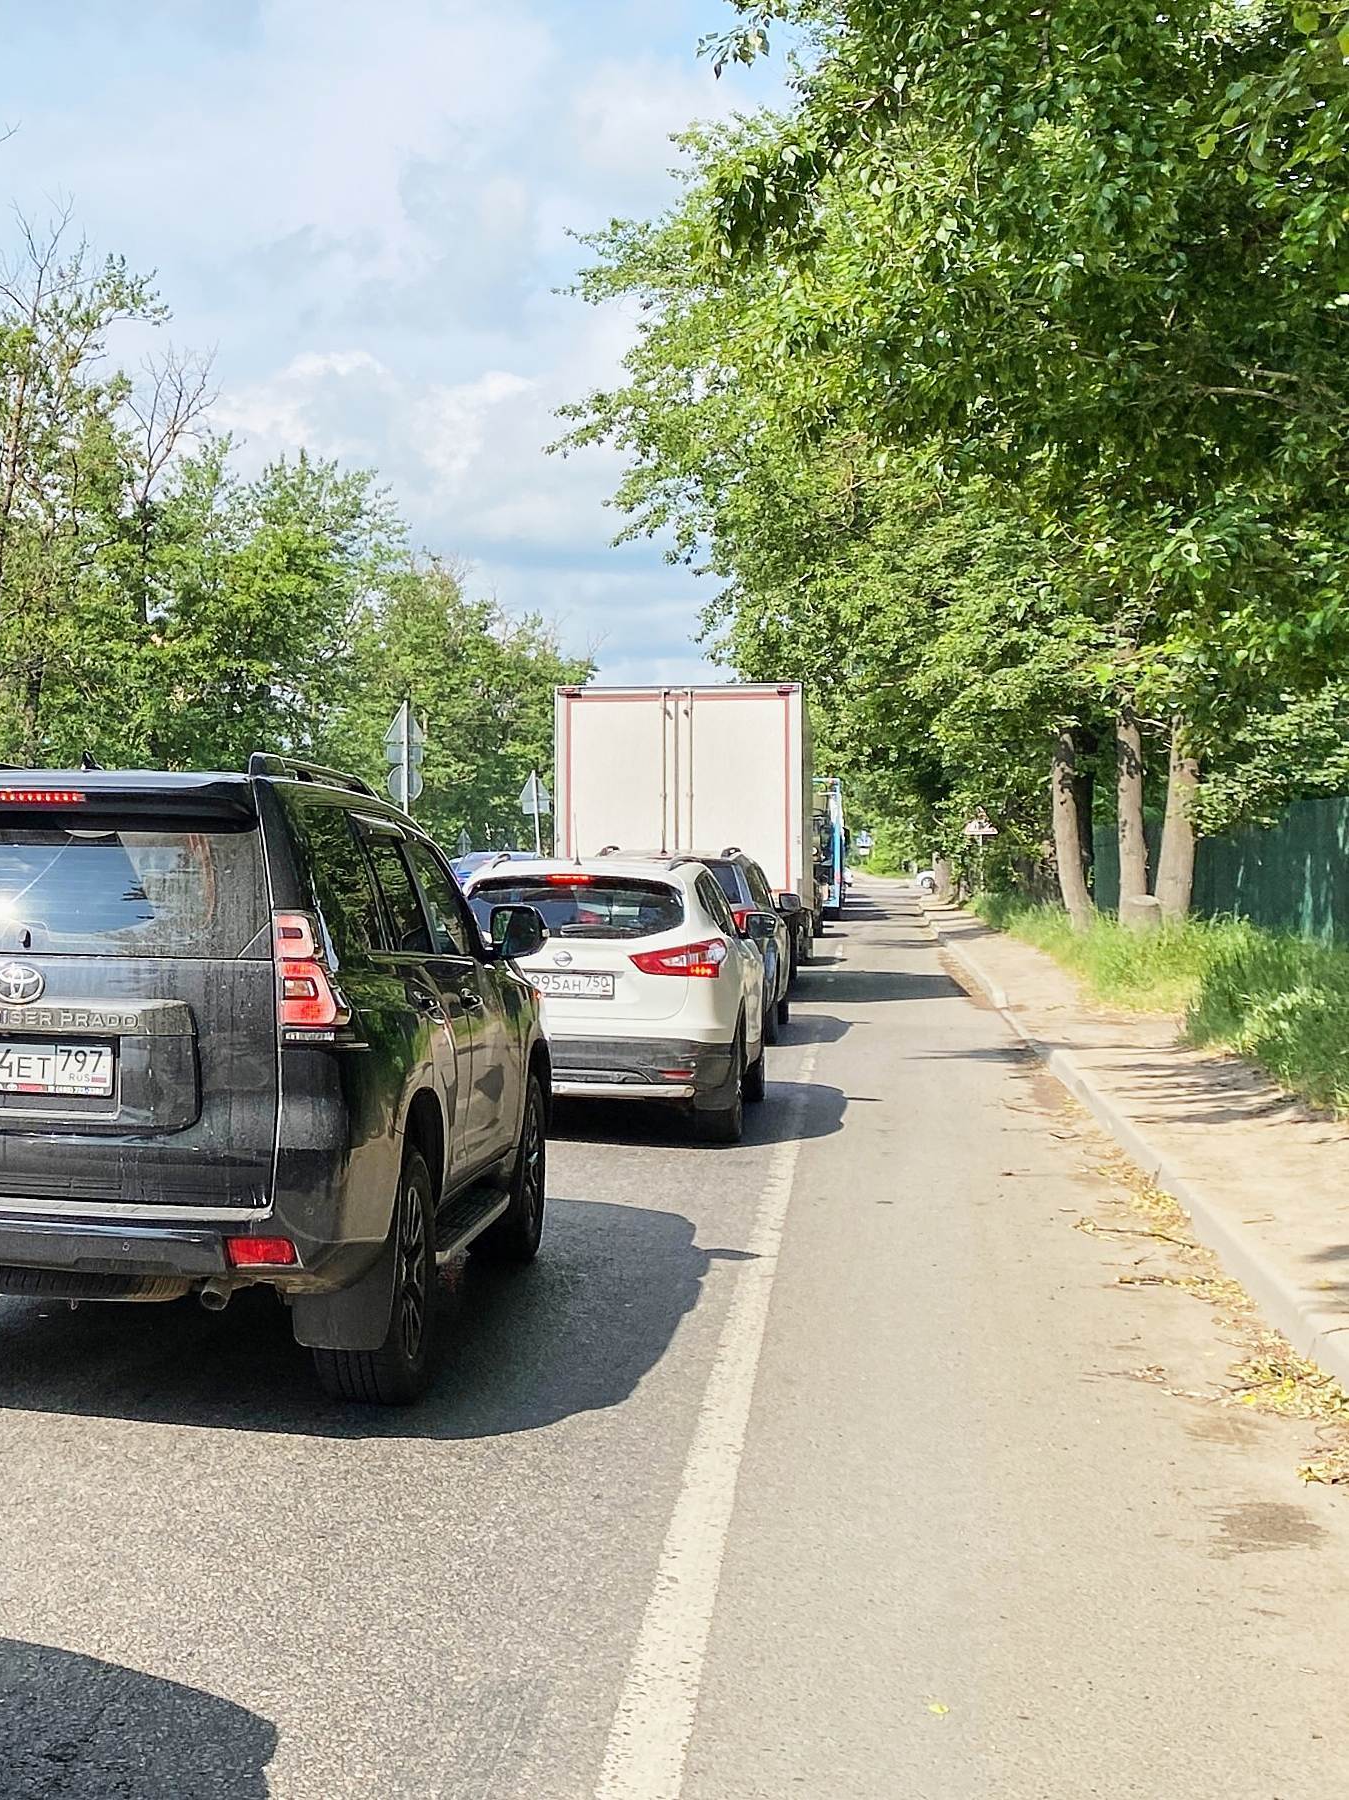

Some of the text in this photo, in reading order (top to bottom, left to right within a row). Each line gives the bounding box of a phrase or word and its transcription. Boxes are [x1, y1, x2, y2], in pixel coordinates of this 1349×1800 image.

[530, 975, 609, 992] 995АН 750
[58, 1011, 139, 1030] PRADO
[58, 1048, 103, 1073] 797
[68, 1073, 91, 1083] RUS
